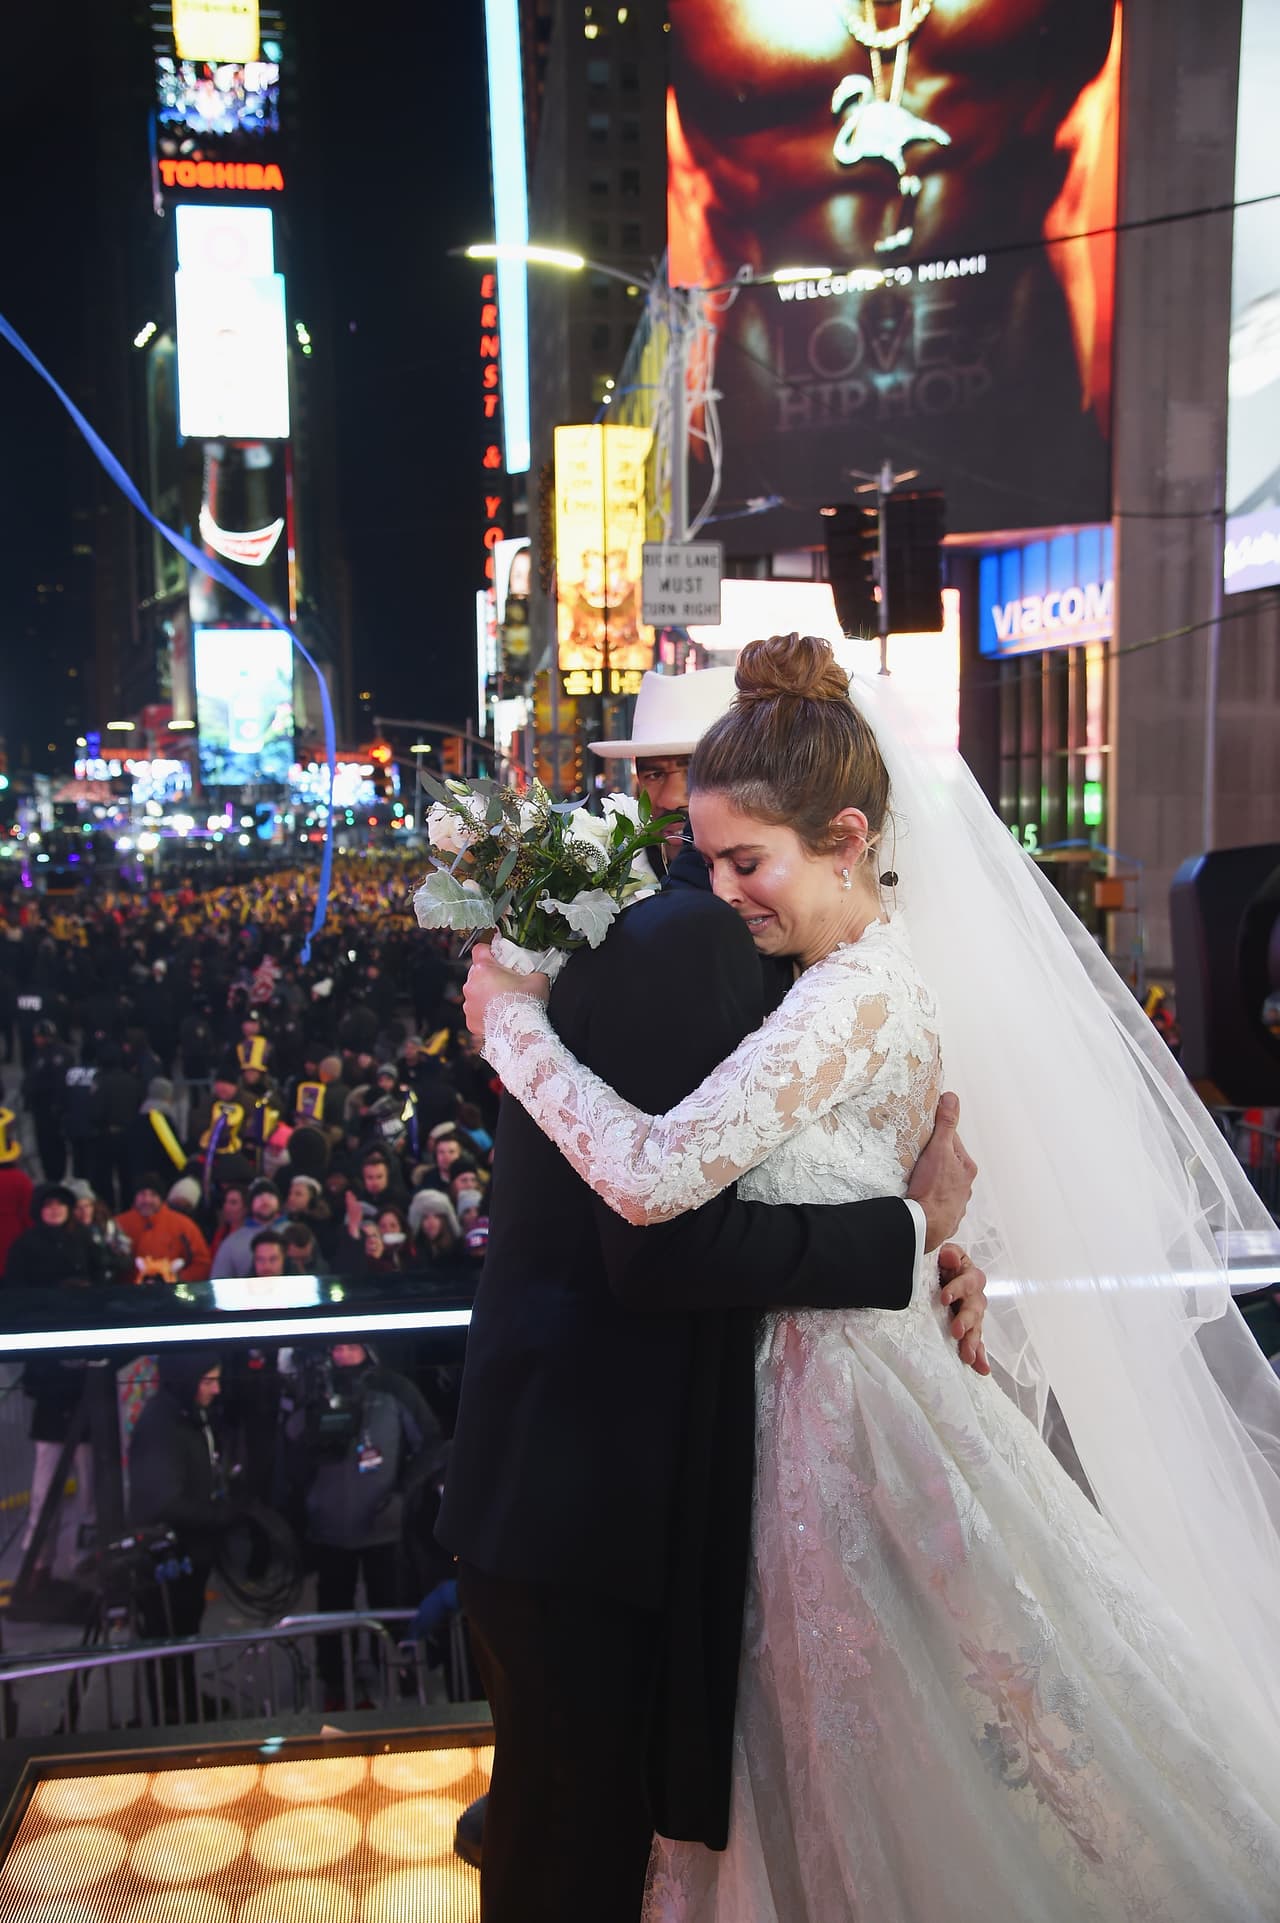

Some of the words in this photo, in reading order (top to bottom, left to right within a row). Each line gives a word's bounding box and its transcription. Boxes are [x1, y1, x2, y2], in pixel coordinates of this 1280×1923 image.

[159, 159, 284, 191] TOSHIBA
[918, 254, 987, 282] MIAMI
[480, 274, 500, 418] ERNST
[775, 297, 957, 383] LOVE
[643, 552, 681, 567] RIGHT
[685, 553, 719, 568] LANE
[659, 577, 703, 594] MUST
[643, 603, 676, 616] TURN
[682, 604, 720, 616] RIGHT
